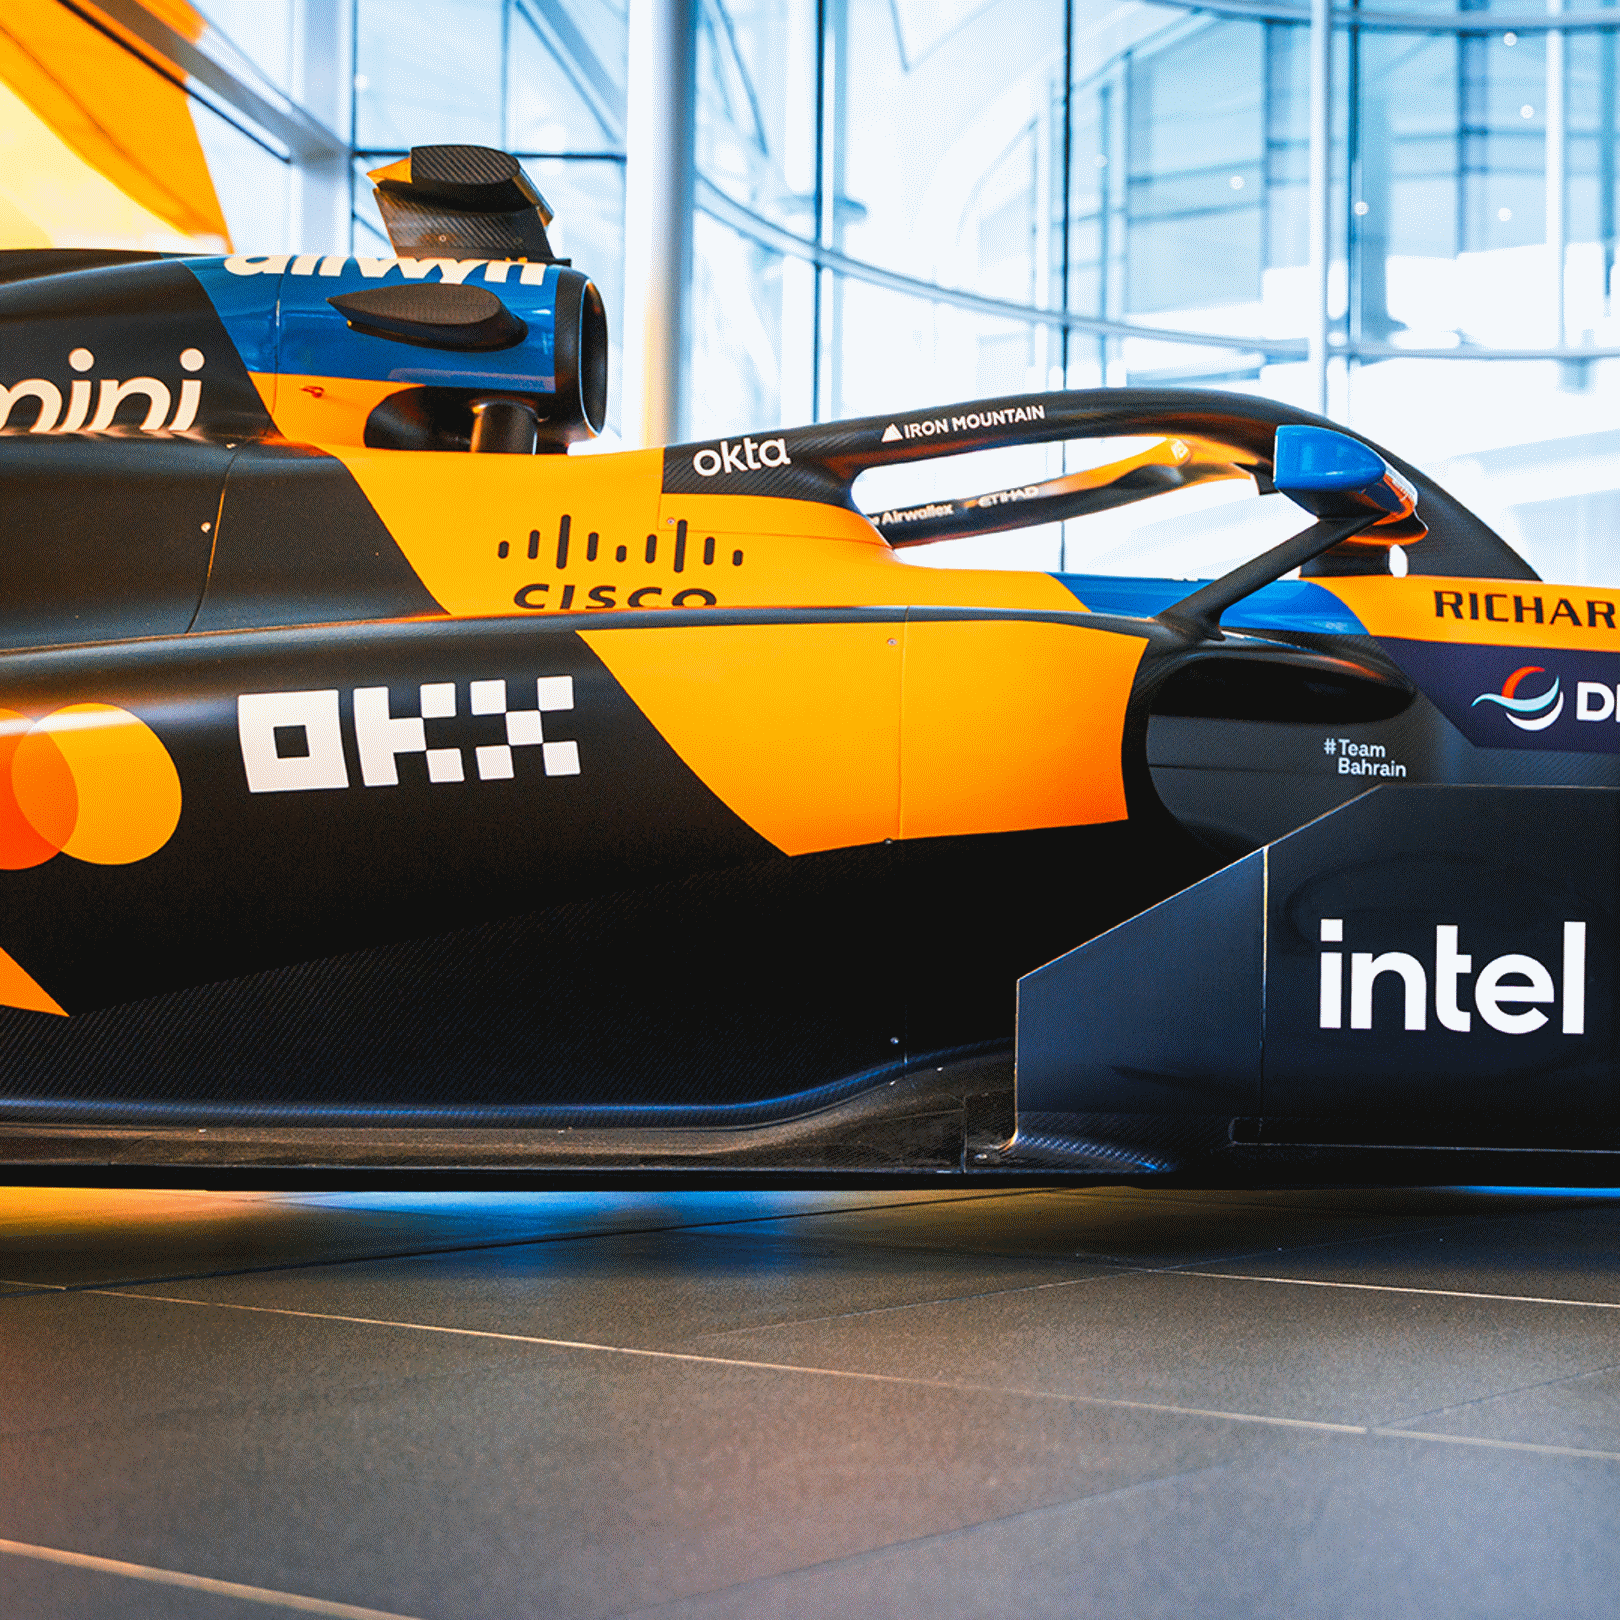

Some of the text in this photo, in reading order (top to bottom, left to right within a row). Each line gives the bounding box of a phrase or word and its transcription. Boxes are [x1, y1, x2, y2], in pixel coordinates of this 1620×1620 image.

[904, 405, 1045, 439] IRON MOUNTAIN
[692, 437, 791, 477] okta
[978, 486, 1039, 508] ETIHAD
[881, 503, 954, 526] Airwallex
[513, 583, 717, 610] CISCO
[1433, 590, 1616, 629] RICHAR
[1576, 681, 1620, 723] D
[237, 675, 581, 793] OKX
[1323, 738, 1386, 758] #Team
[1338, 757, 1407, 778] Bahrain
[1319, 918, 1586, 1034] intel
